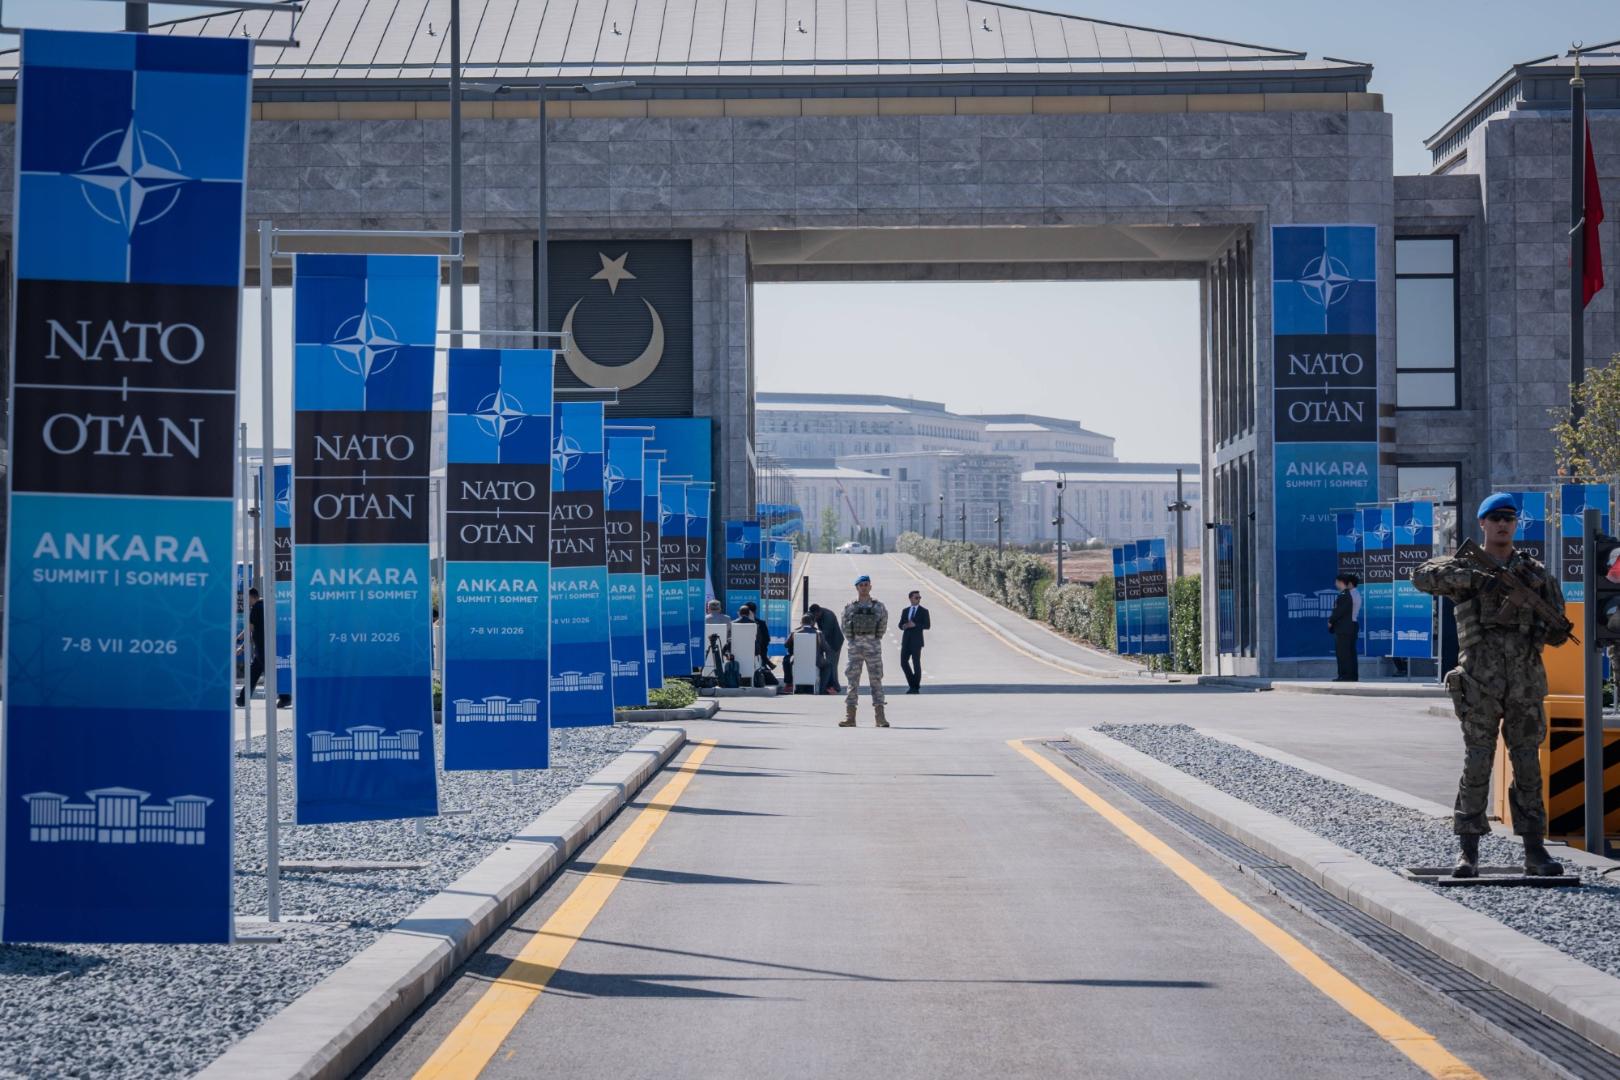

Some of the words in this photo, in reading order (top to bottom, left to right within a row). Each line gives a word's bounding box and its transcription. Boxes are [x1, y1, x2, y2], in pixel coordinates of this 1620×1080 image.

[44, 319, 205, 365] NATO
[1288, 352, 1364, 375] NATO
[1288, 401, 1364, 423] OTAN
[42, 412, 205, 459] OTAN
[313, 434, 415, 461] NATO
[1286, 461, 1368, 476] ANKARA
[460, 480, 536, 501] NATO
[1286, 480, 1321, 488] SUMMIT
[1329, 479, 1368, 488] SOMMET
[313, 493, 415, 520] OTAN
[551, 504, 594, 521] ATO
[460, 524, 535, 544] OTAN
[607, 521, 633, 535] TO
[33, 531, 209, 563] ANKARA
[551, 537, 595, 554] TAN
[607, 549, 633, 562] AN
[1399, 550, 1428, 559] NATO
[33, 568, 108, 585] SUMMIT
[126, 570, 209, 587] SOMMET
[309, 567, 418, 586] ANKARA
[1398, 566, 1414, 575] OT
[1568, 564, 1585, 575] OT
[456, 578, 538, 593] ANKARA
[549, 579, 600, 591] NKARA
[610, 584, 636, 593] ARA
[309, 590, 356, 601] SUMMIT
[367, 590, 418, 600] SOMMET
[456, 595, 492, 603] SUMMIT
[499, 595, 538, 603] SOMMET
[328, 633, 348, 643] 7-8
[350, 633, 367, 642] VII
[371, 632, 400, 642] 2026
[486, 627, 499, 635] VII
[61, 636, 91, 652] 7-8
[98, 637, 123, 653] VII
[129, 639, 178, 654] 2026
